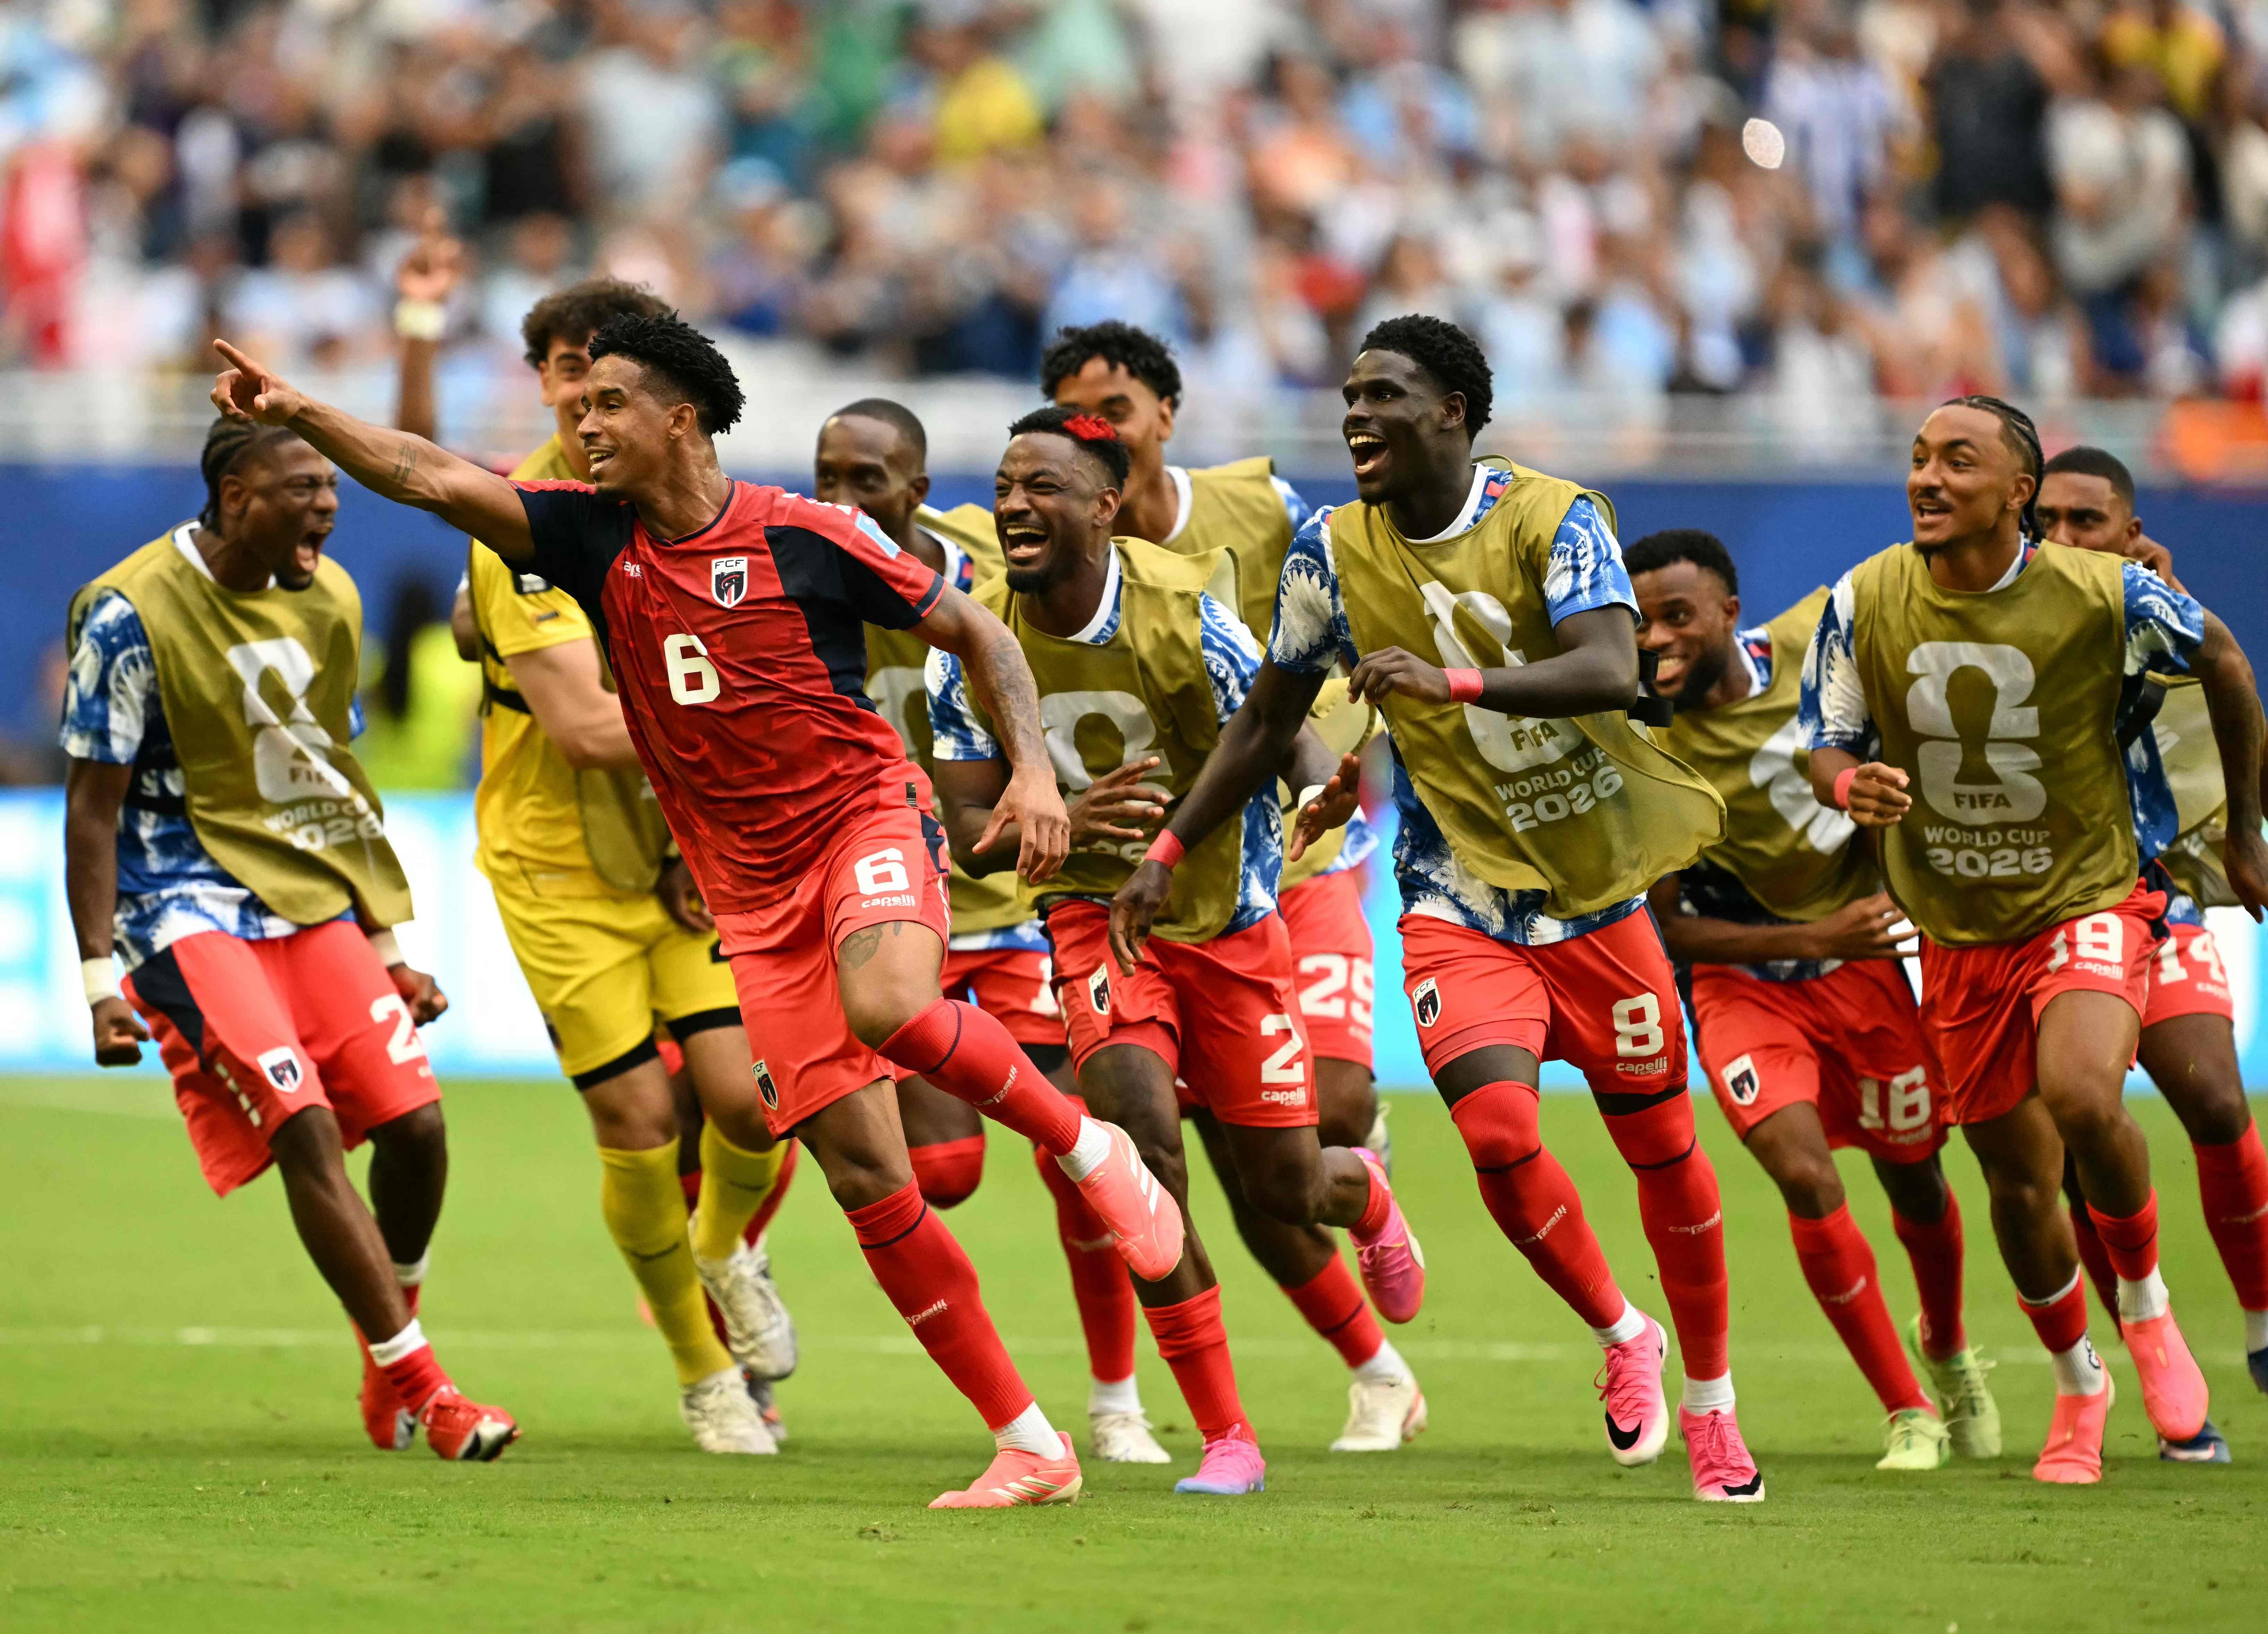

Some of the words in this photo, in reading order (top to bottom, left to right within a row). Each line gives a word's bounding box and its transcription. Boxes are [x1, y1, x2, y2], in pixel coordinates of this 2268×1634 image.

[715, 559, 744, 569] FCF
[663, 633, 720, 706] 6
[1494, 769, 1571, 801] WORLD
[1506, 765, 1623, 832] 2026
[1953, 793, 2013, 809] FIFA
[1924, 825, 2003, 847] WORLD
[2006, 829, 2051, 846] CUP
[854, 847, 910, 895] 6
[1926, 846, 2053, 878] 2026
[861, 894, 915, 908] capelli
[2159, 931, 2227, 986] 14
[1414, 978, 1434, 999] FCF
[1612, 992, 1664, 1058] 8
[1261, 1013, 1305, 1084] 2
[753, 1062, 764, 1076] FCF
[1616, 1056, 1667, 1075] capelli
[1261, 1086, 1306, 1105] capelli
[1858, 1064, 1931, 1131] 16
